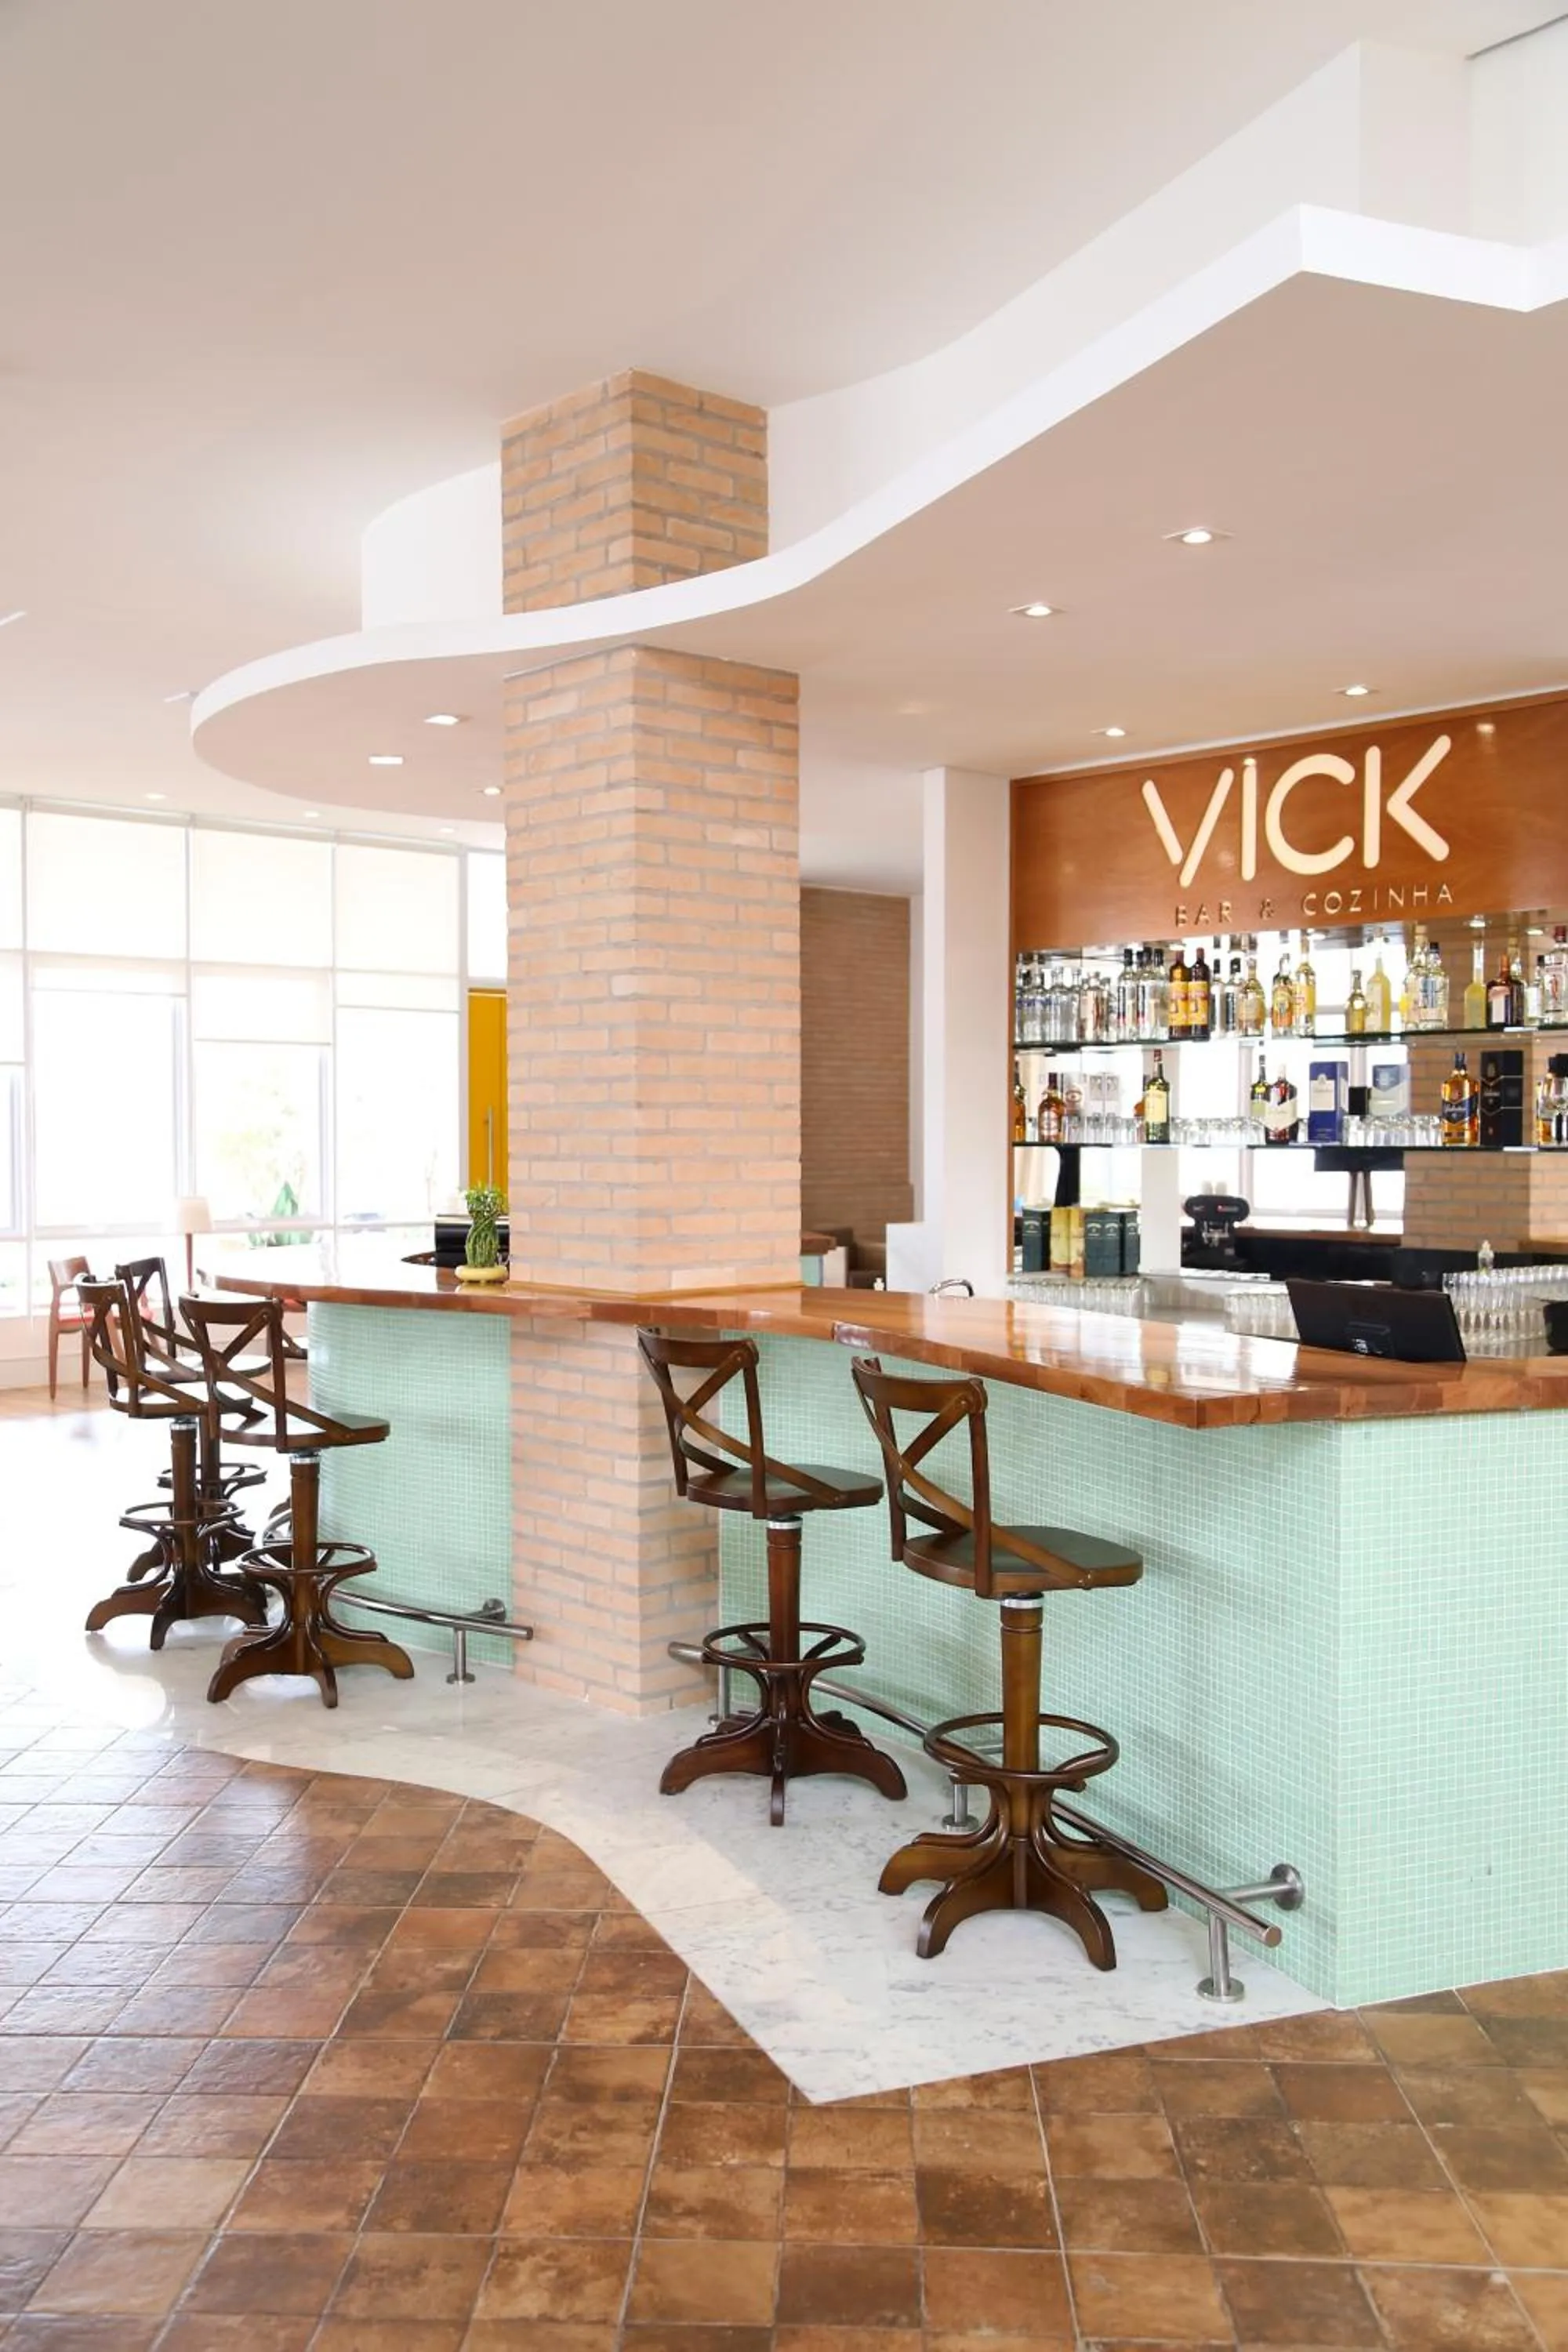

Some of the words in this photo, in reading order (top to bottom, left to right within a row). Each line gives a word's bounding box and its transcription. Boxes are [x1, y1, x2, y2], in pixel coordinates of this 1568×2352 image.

[1142, 735, 1452, 888] VICK
[1175, 901, 1233, 927] BAR
[1259, 898, 1276, 920] &
[1302, 884, 1454, 916] COZINHA
